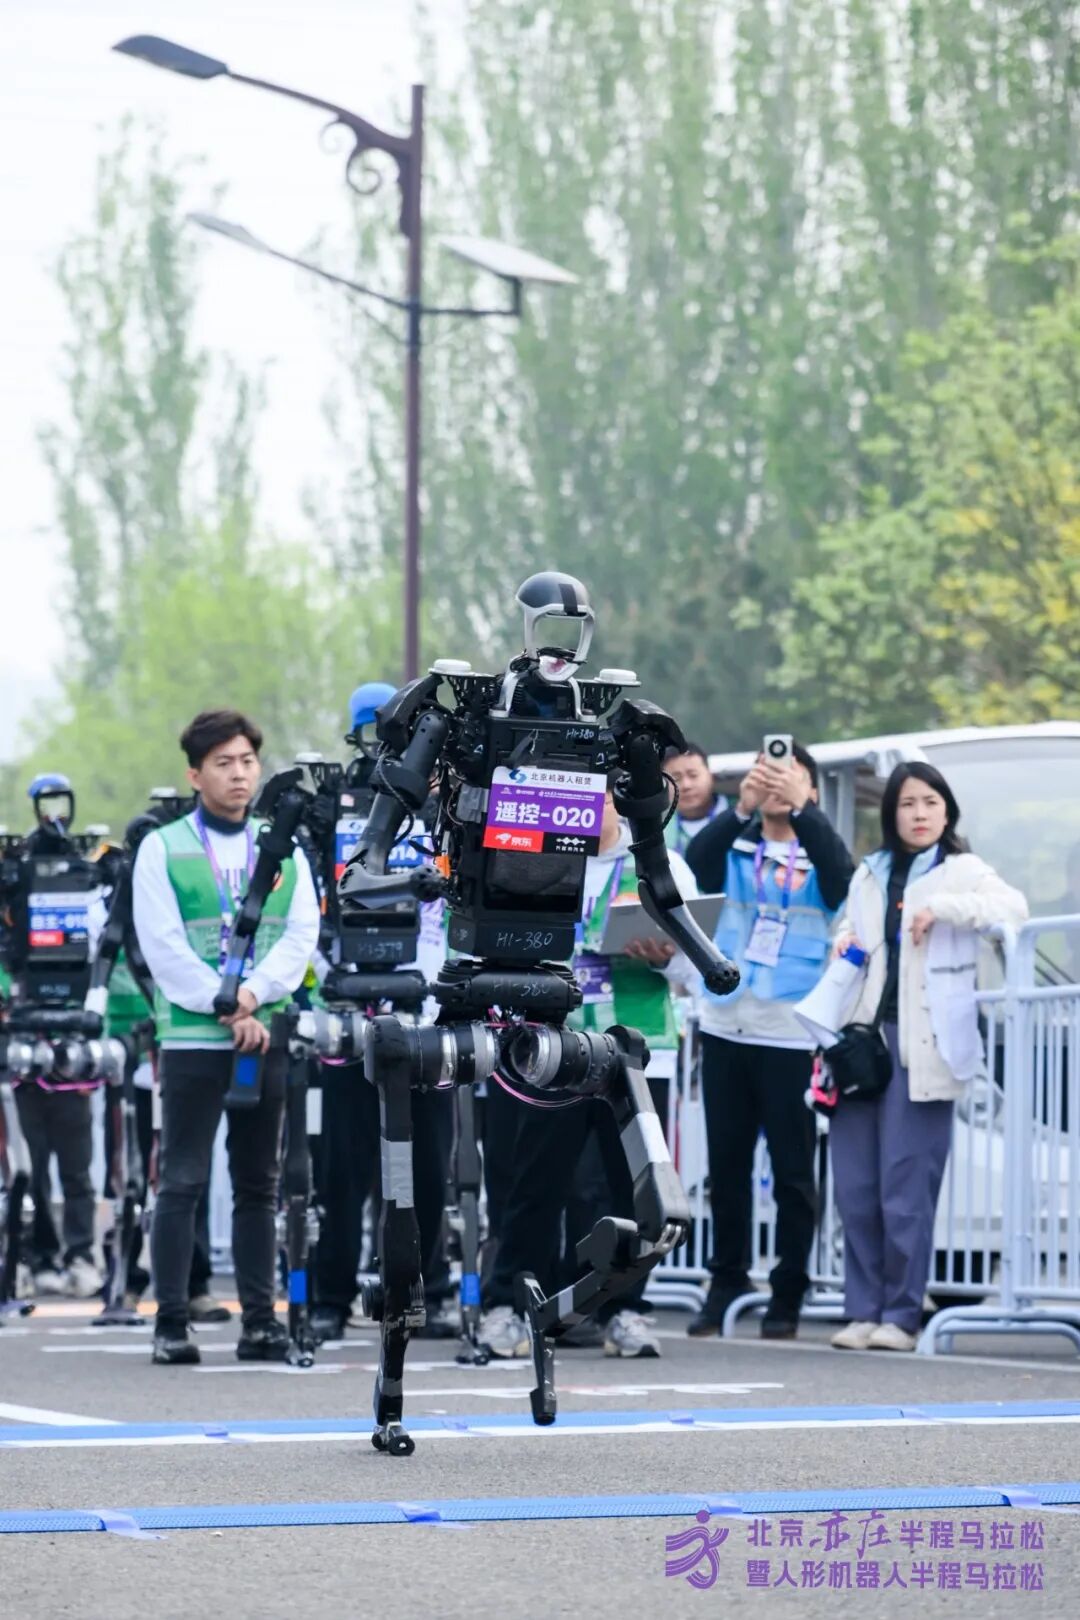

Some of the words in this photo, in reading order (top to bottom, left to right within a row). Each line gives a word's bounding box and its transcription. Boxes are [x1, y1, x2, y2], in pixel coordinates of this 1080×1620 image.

[530, 772, 592, 786] 北京机器人租赁
[494, 800, 596, 829] 遥控-020
